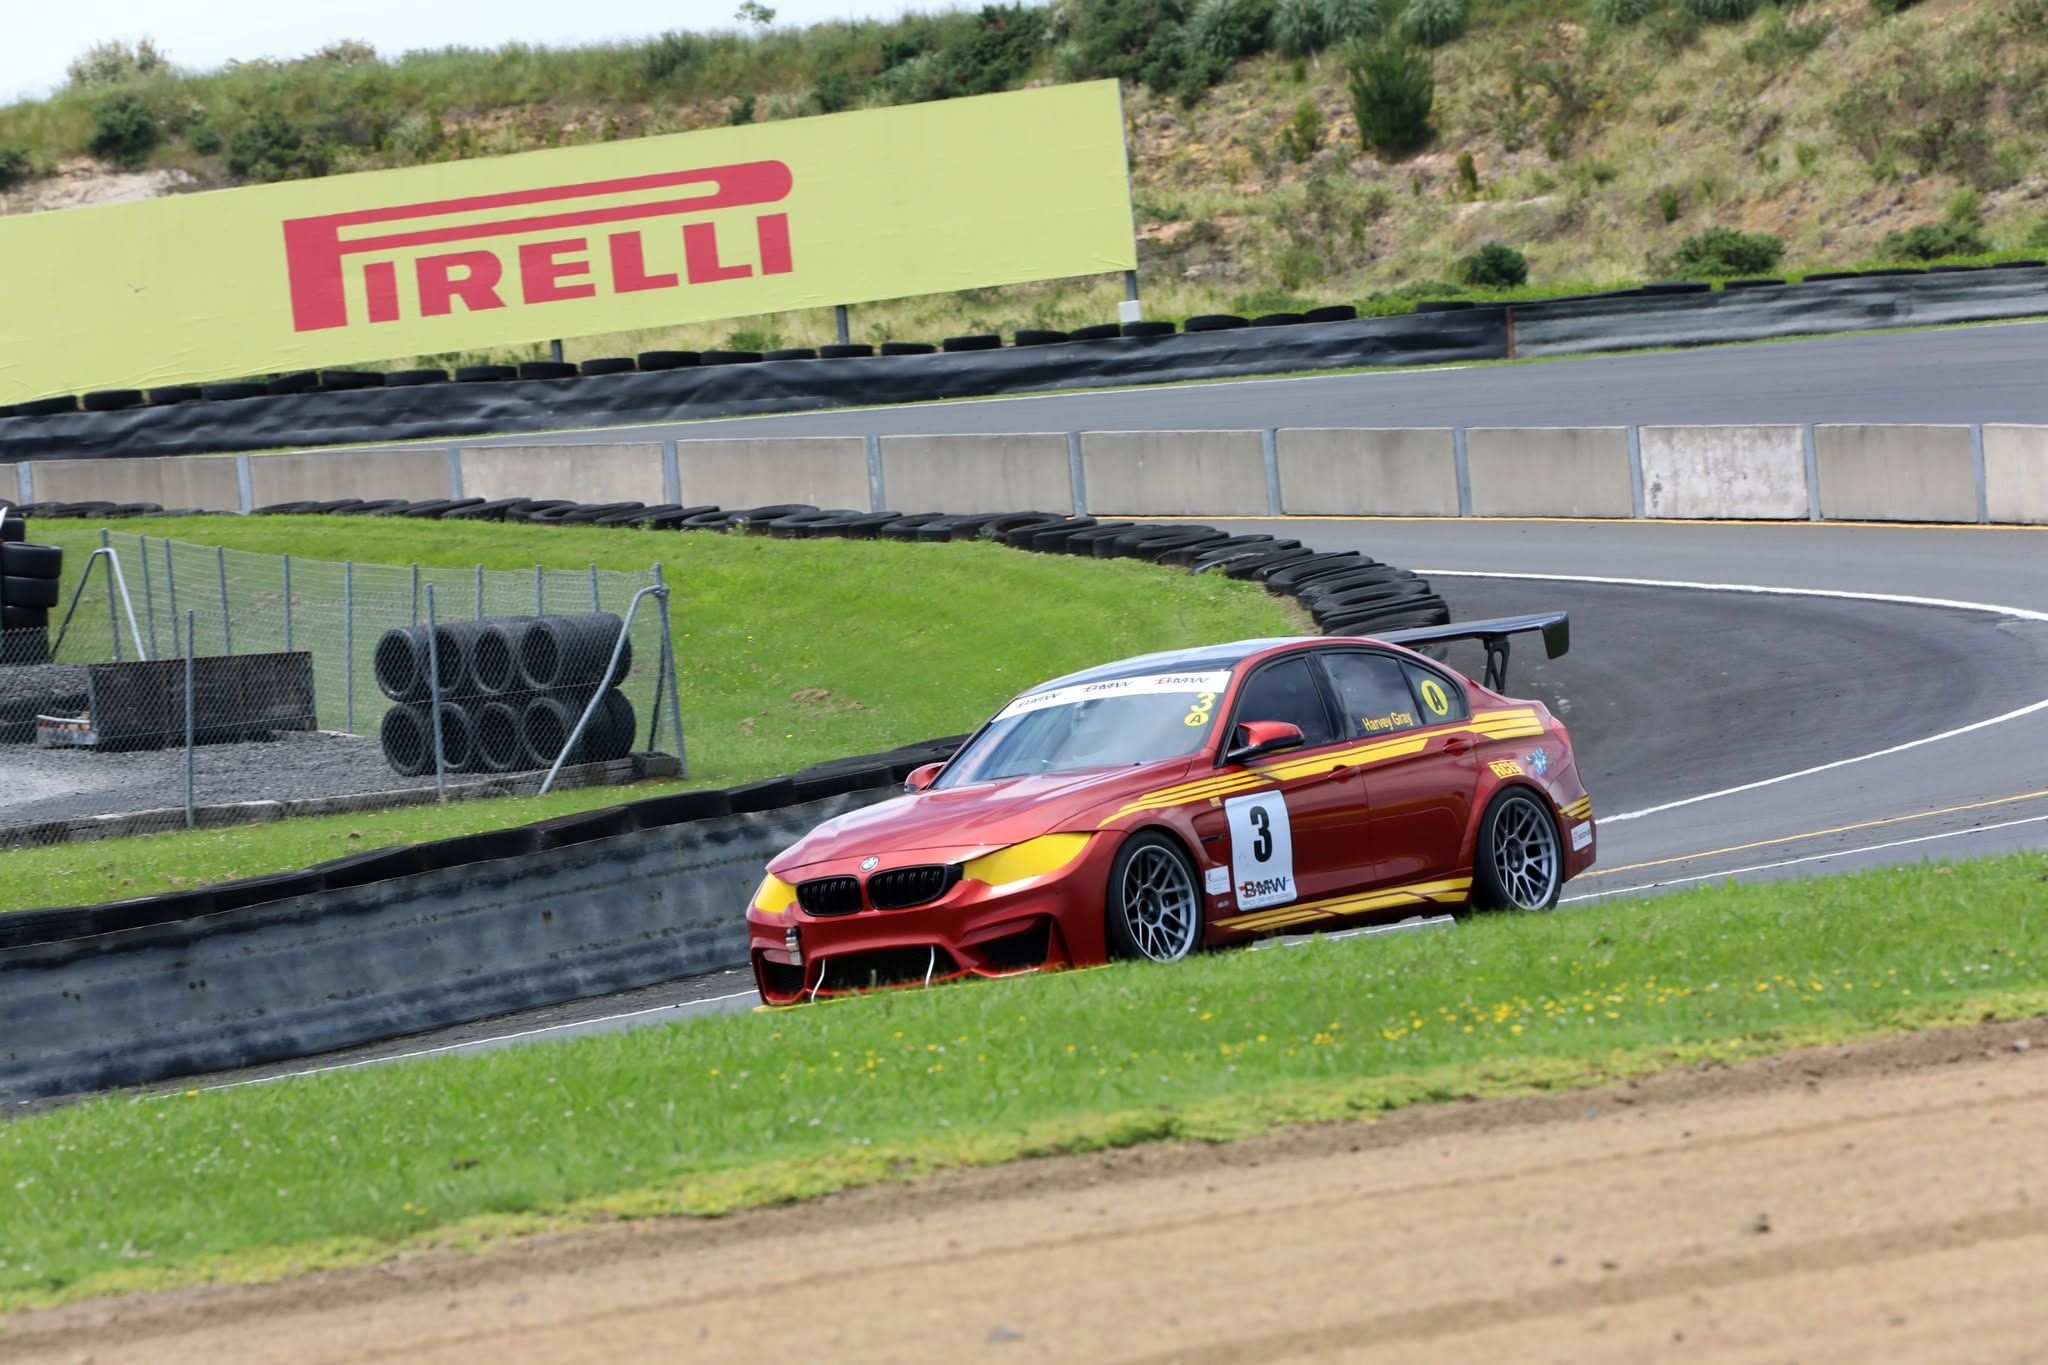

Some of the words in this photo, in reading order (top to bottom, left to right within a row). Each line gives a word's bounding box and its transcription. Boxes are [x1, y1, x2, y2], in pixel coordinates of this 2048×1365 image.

[282, 160, 793, 332] PIRELLI
[1191, 692, 1216, 712] 3
[1427, 685, 1445, 711] A
[1190, 714, 1201, 724] A
[1362, 717, 1394, 731] Harvey
[1391, 712, 1413, 726] Gray
[1249, 806, 1272, 863] 3
[1240, 876, 1287, 898] BMW
